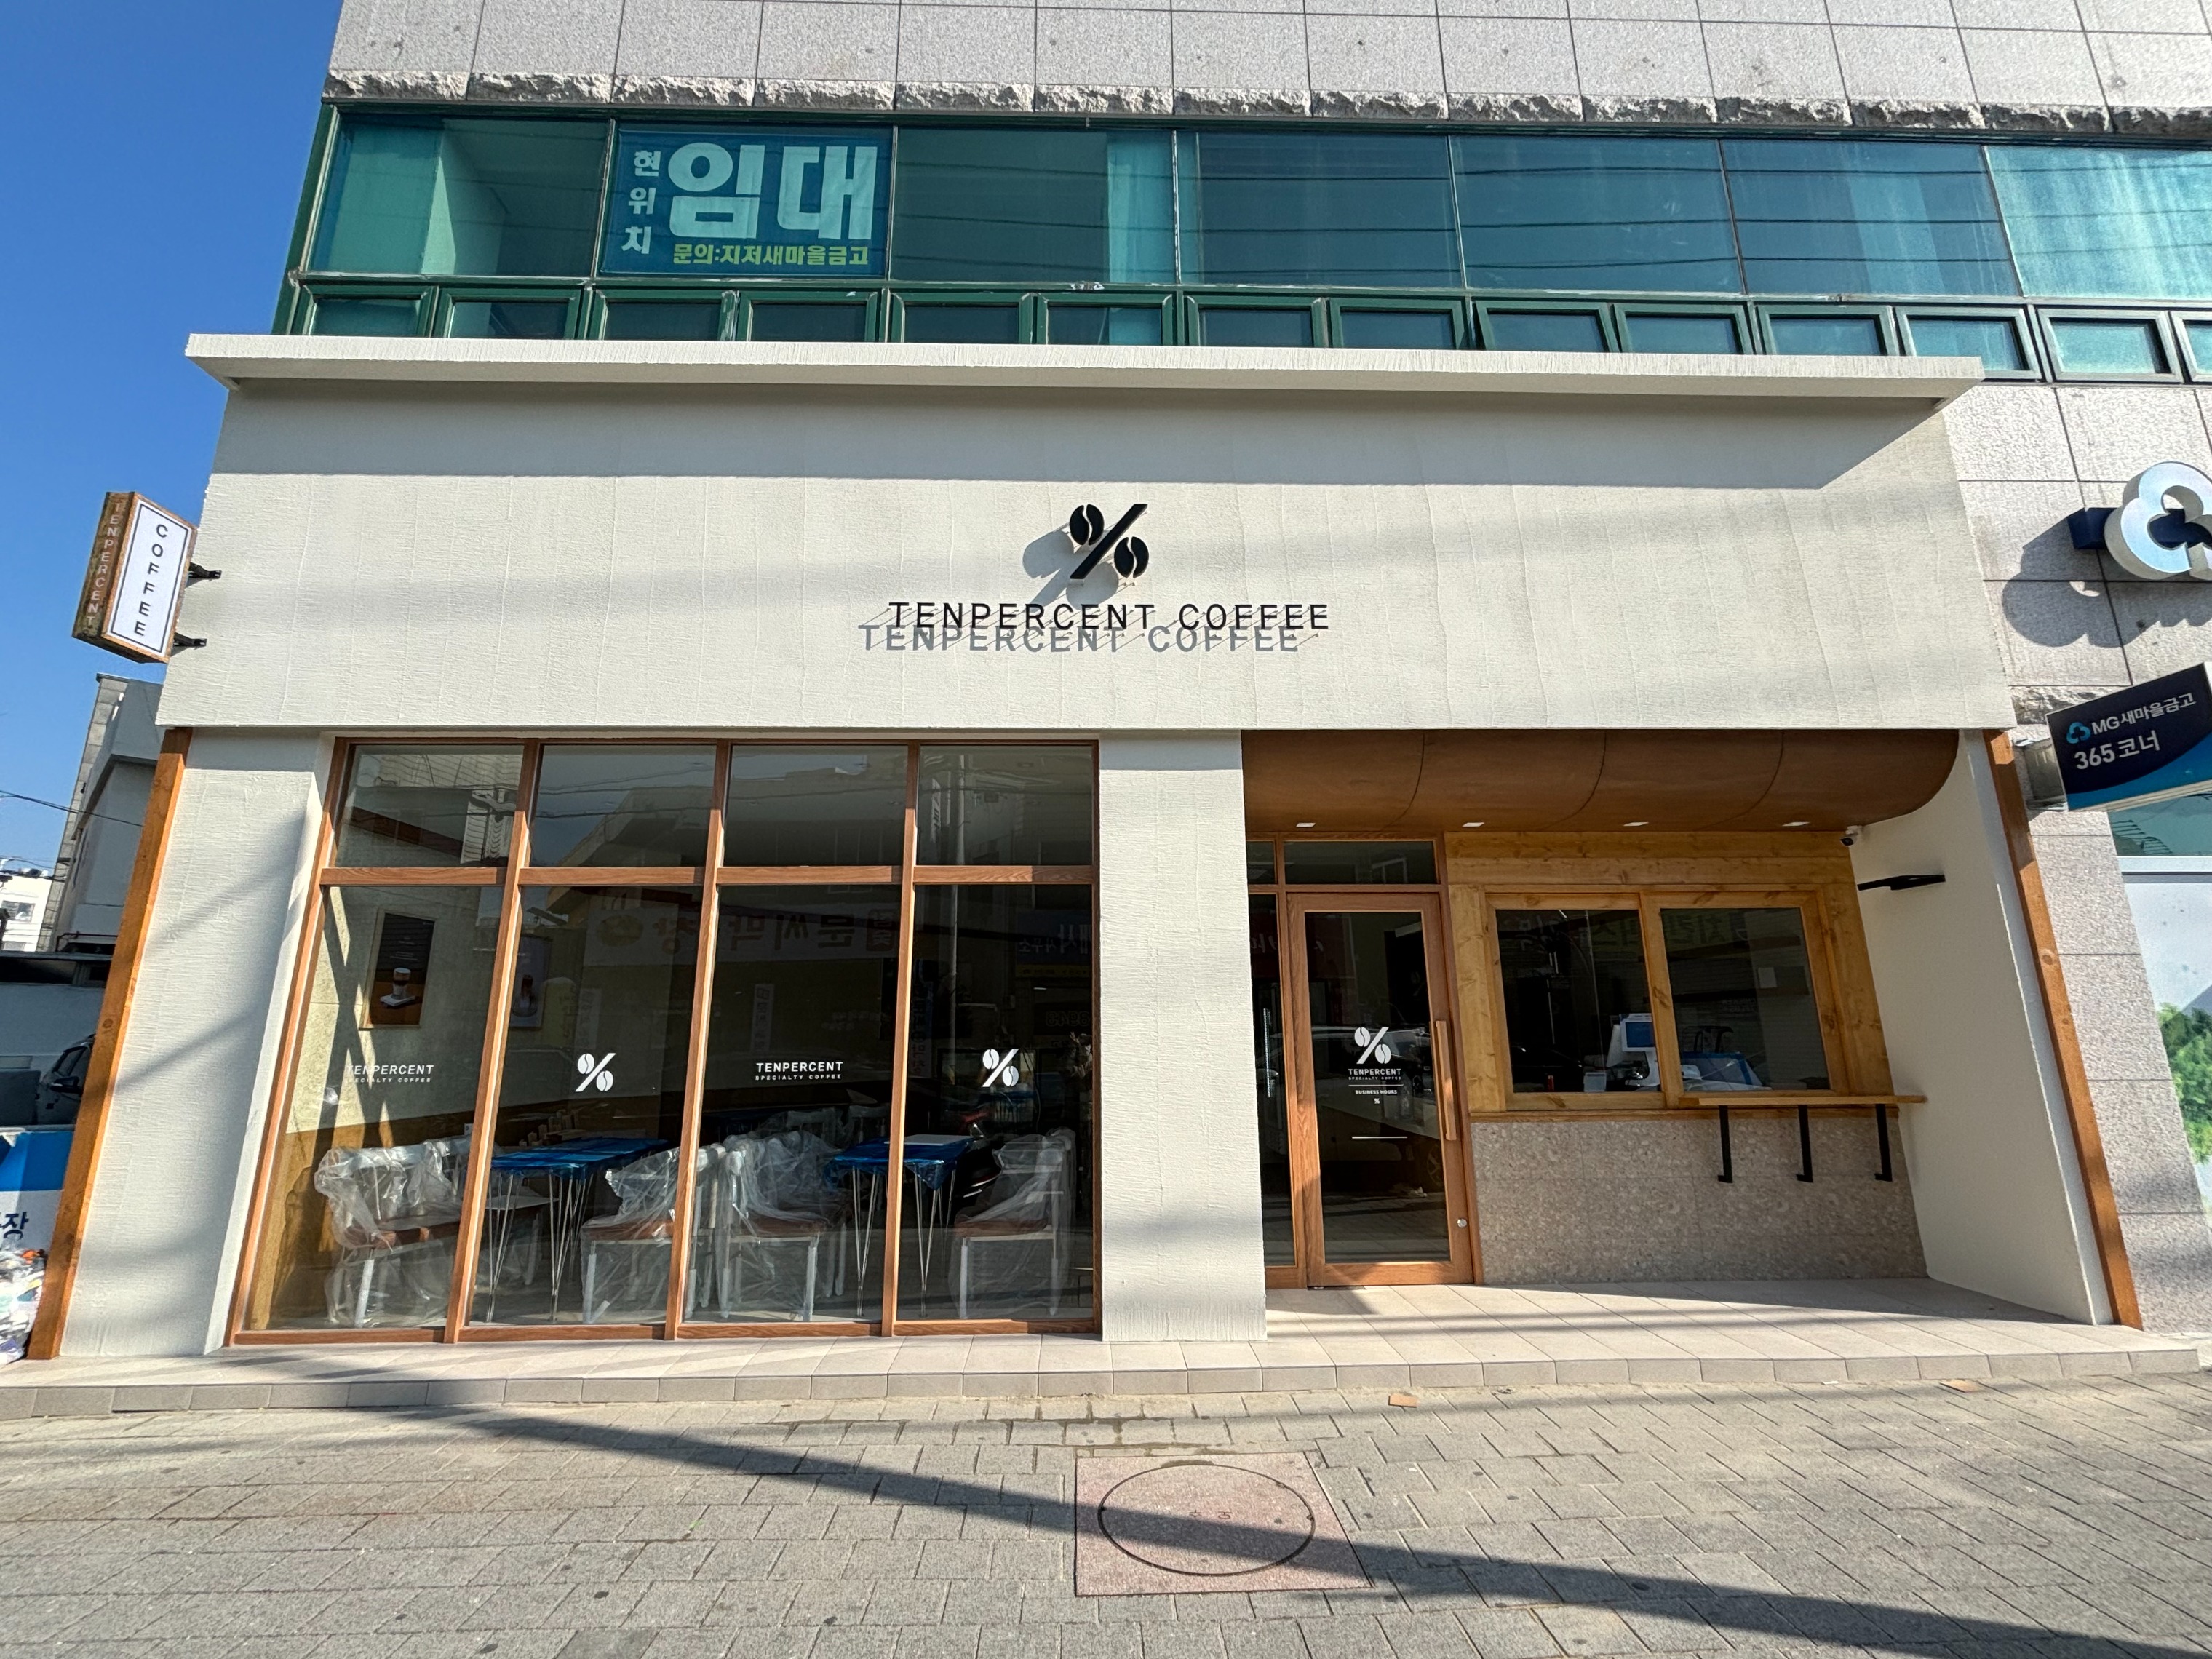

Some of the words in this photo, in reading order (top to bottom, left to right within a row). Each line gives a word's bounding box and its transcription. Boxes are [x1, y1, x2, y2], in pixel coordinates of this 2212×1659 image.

[621, 150, 661, 255] 현위치
[667, 142, 878, 239] 임대
[87, 503, 122, 626] TENPERCENT
[134, 524, 168, 637] COFFEE
[888, 602, 1155, 629] TENPERCENT
[1178, 602, 1329, 630] COFFEE
[2092, 693, 2197, 735] MG새마을금고
[755, 1061, 844, 1073] TENPERCENT
[0, 1212, 29, 1240] 장
